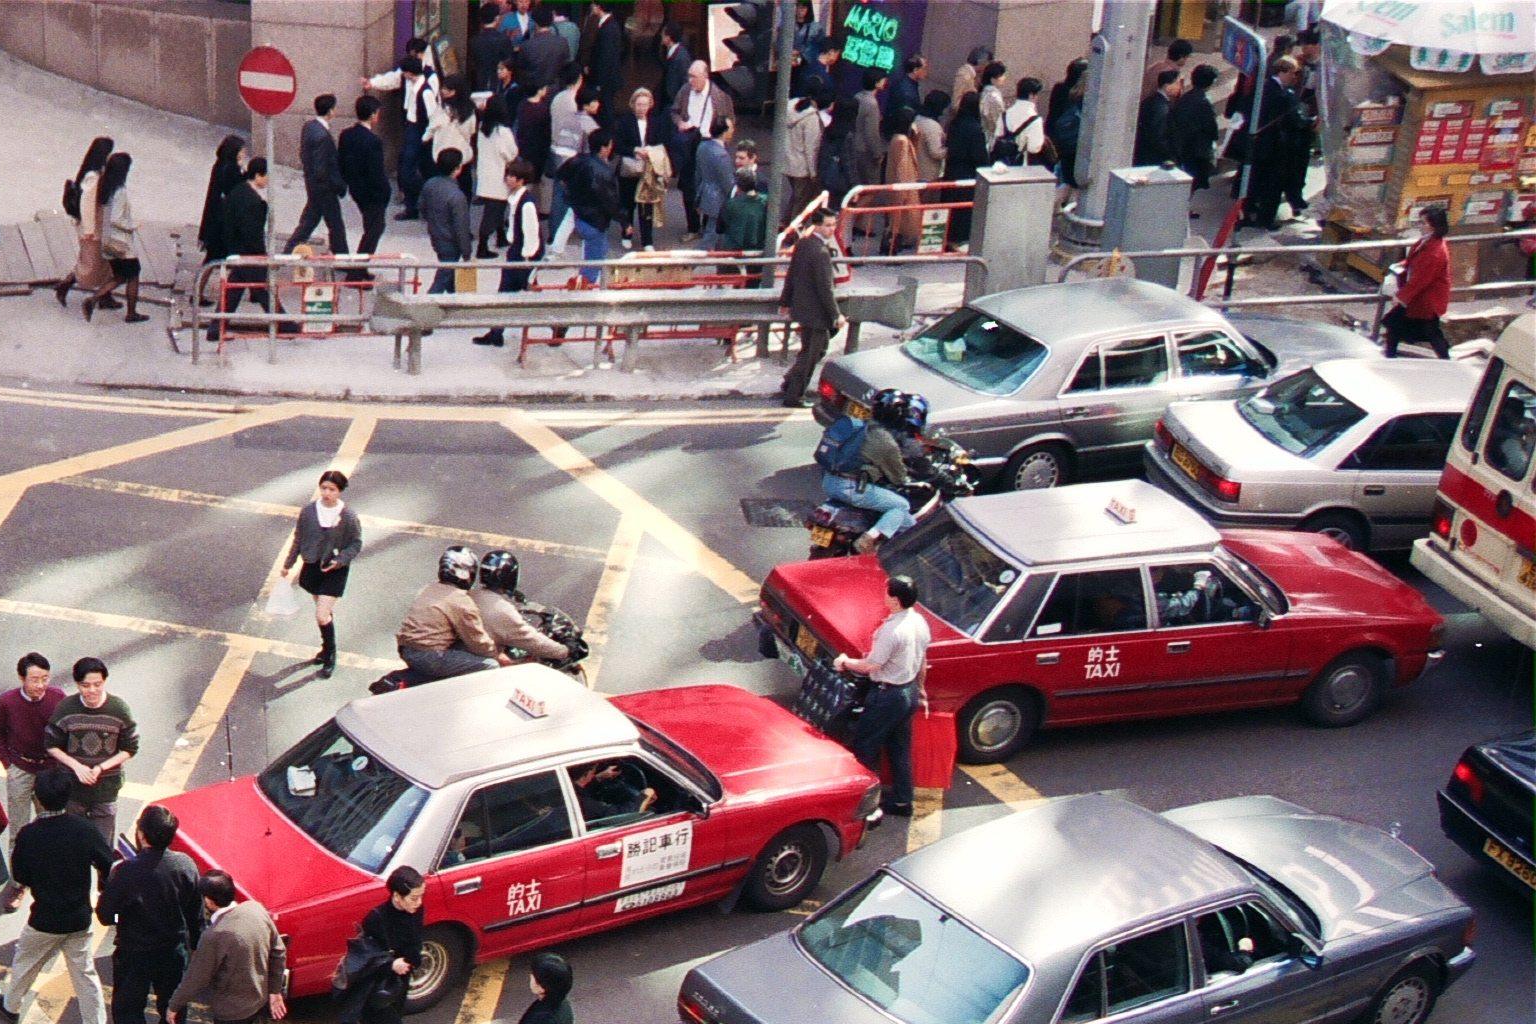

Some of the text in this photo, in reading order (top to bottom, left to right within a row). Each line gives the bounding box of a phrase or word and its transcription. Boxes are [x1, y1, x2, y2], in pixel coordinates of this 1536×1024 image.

[1087, 646, 1119, 662] 的士
[1084, 663, 1120, 679] TAXI
[507, 879, 541, 900] 的士
[506, 894, 542, 917] TAXI
